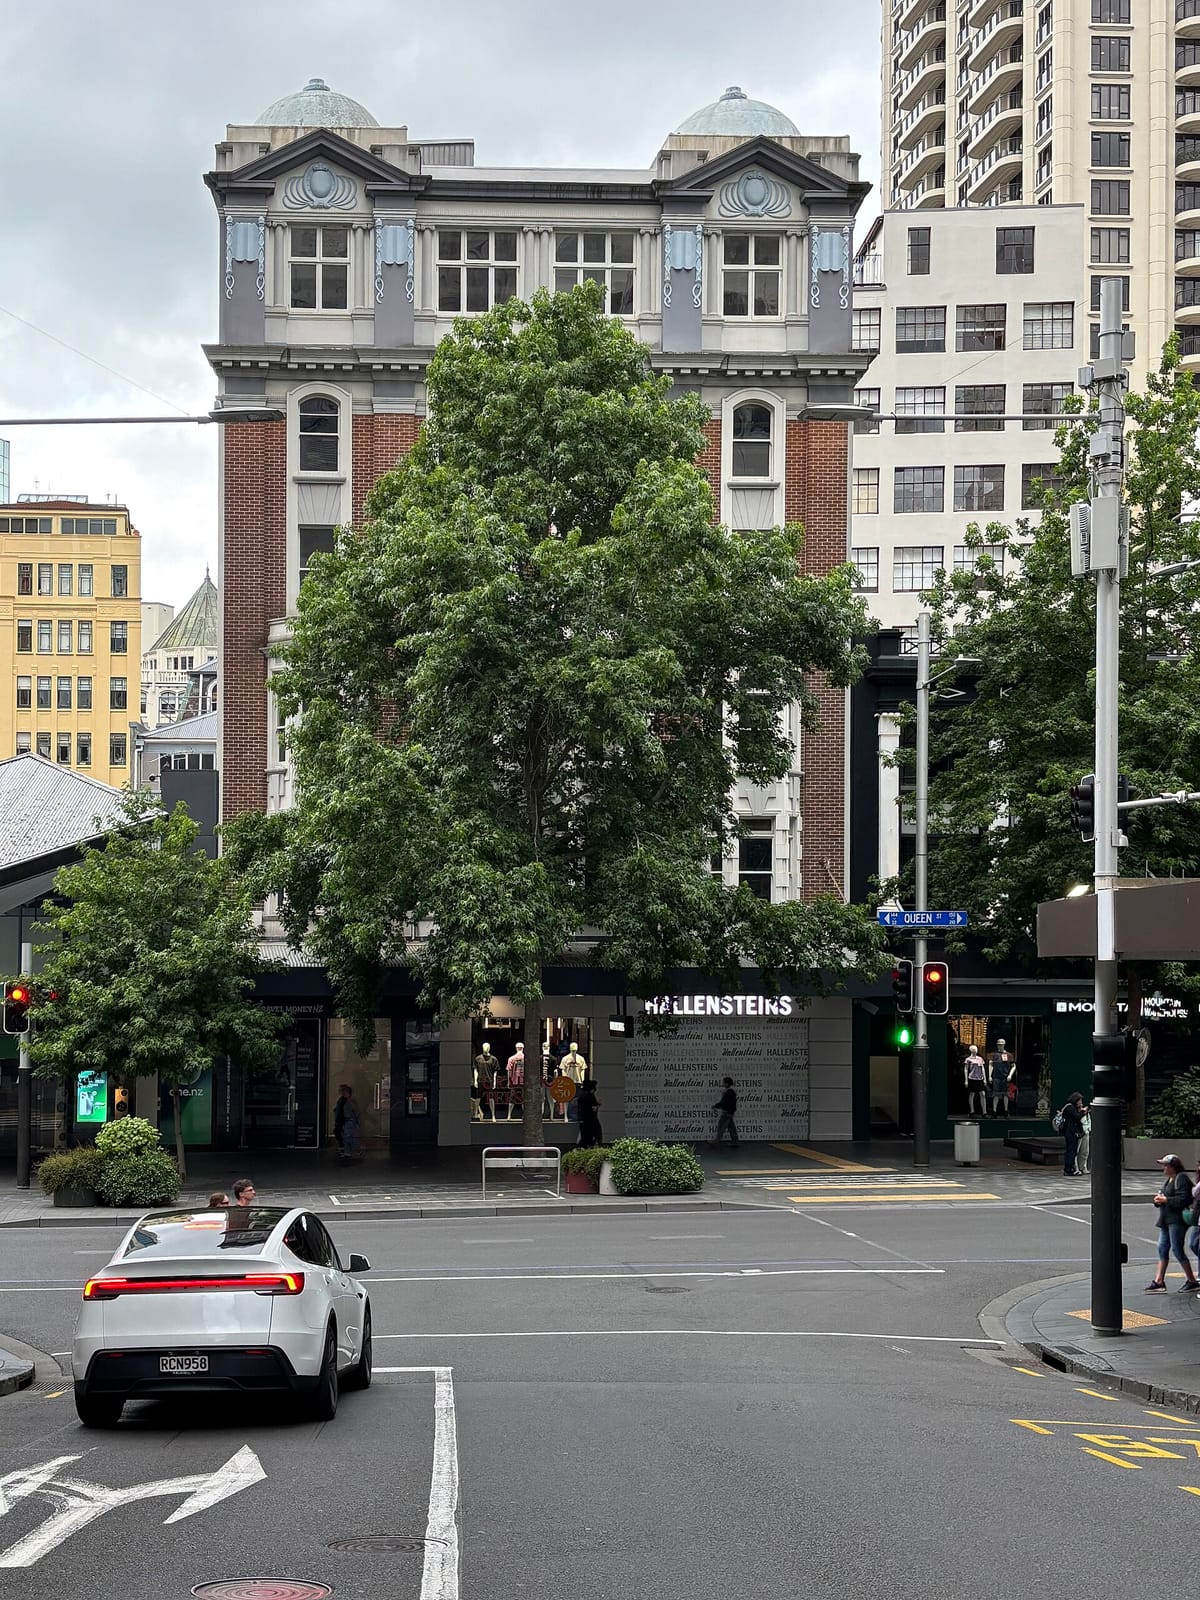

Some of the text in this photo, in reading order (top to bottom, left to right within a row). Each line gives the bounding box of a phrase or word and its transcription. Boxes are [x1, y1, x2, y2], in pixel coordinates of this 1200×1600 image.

[904, 913, 932, 924] QUEEN
[708, 1032, 762, 1041] HALLENSTEINS
[664, 1063, 718, 1072] HALLENSTEINS
[664, 1110, 719, 1118] HALLENSTEINS
[161, 1357, 207, 1370] RCN958
